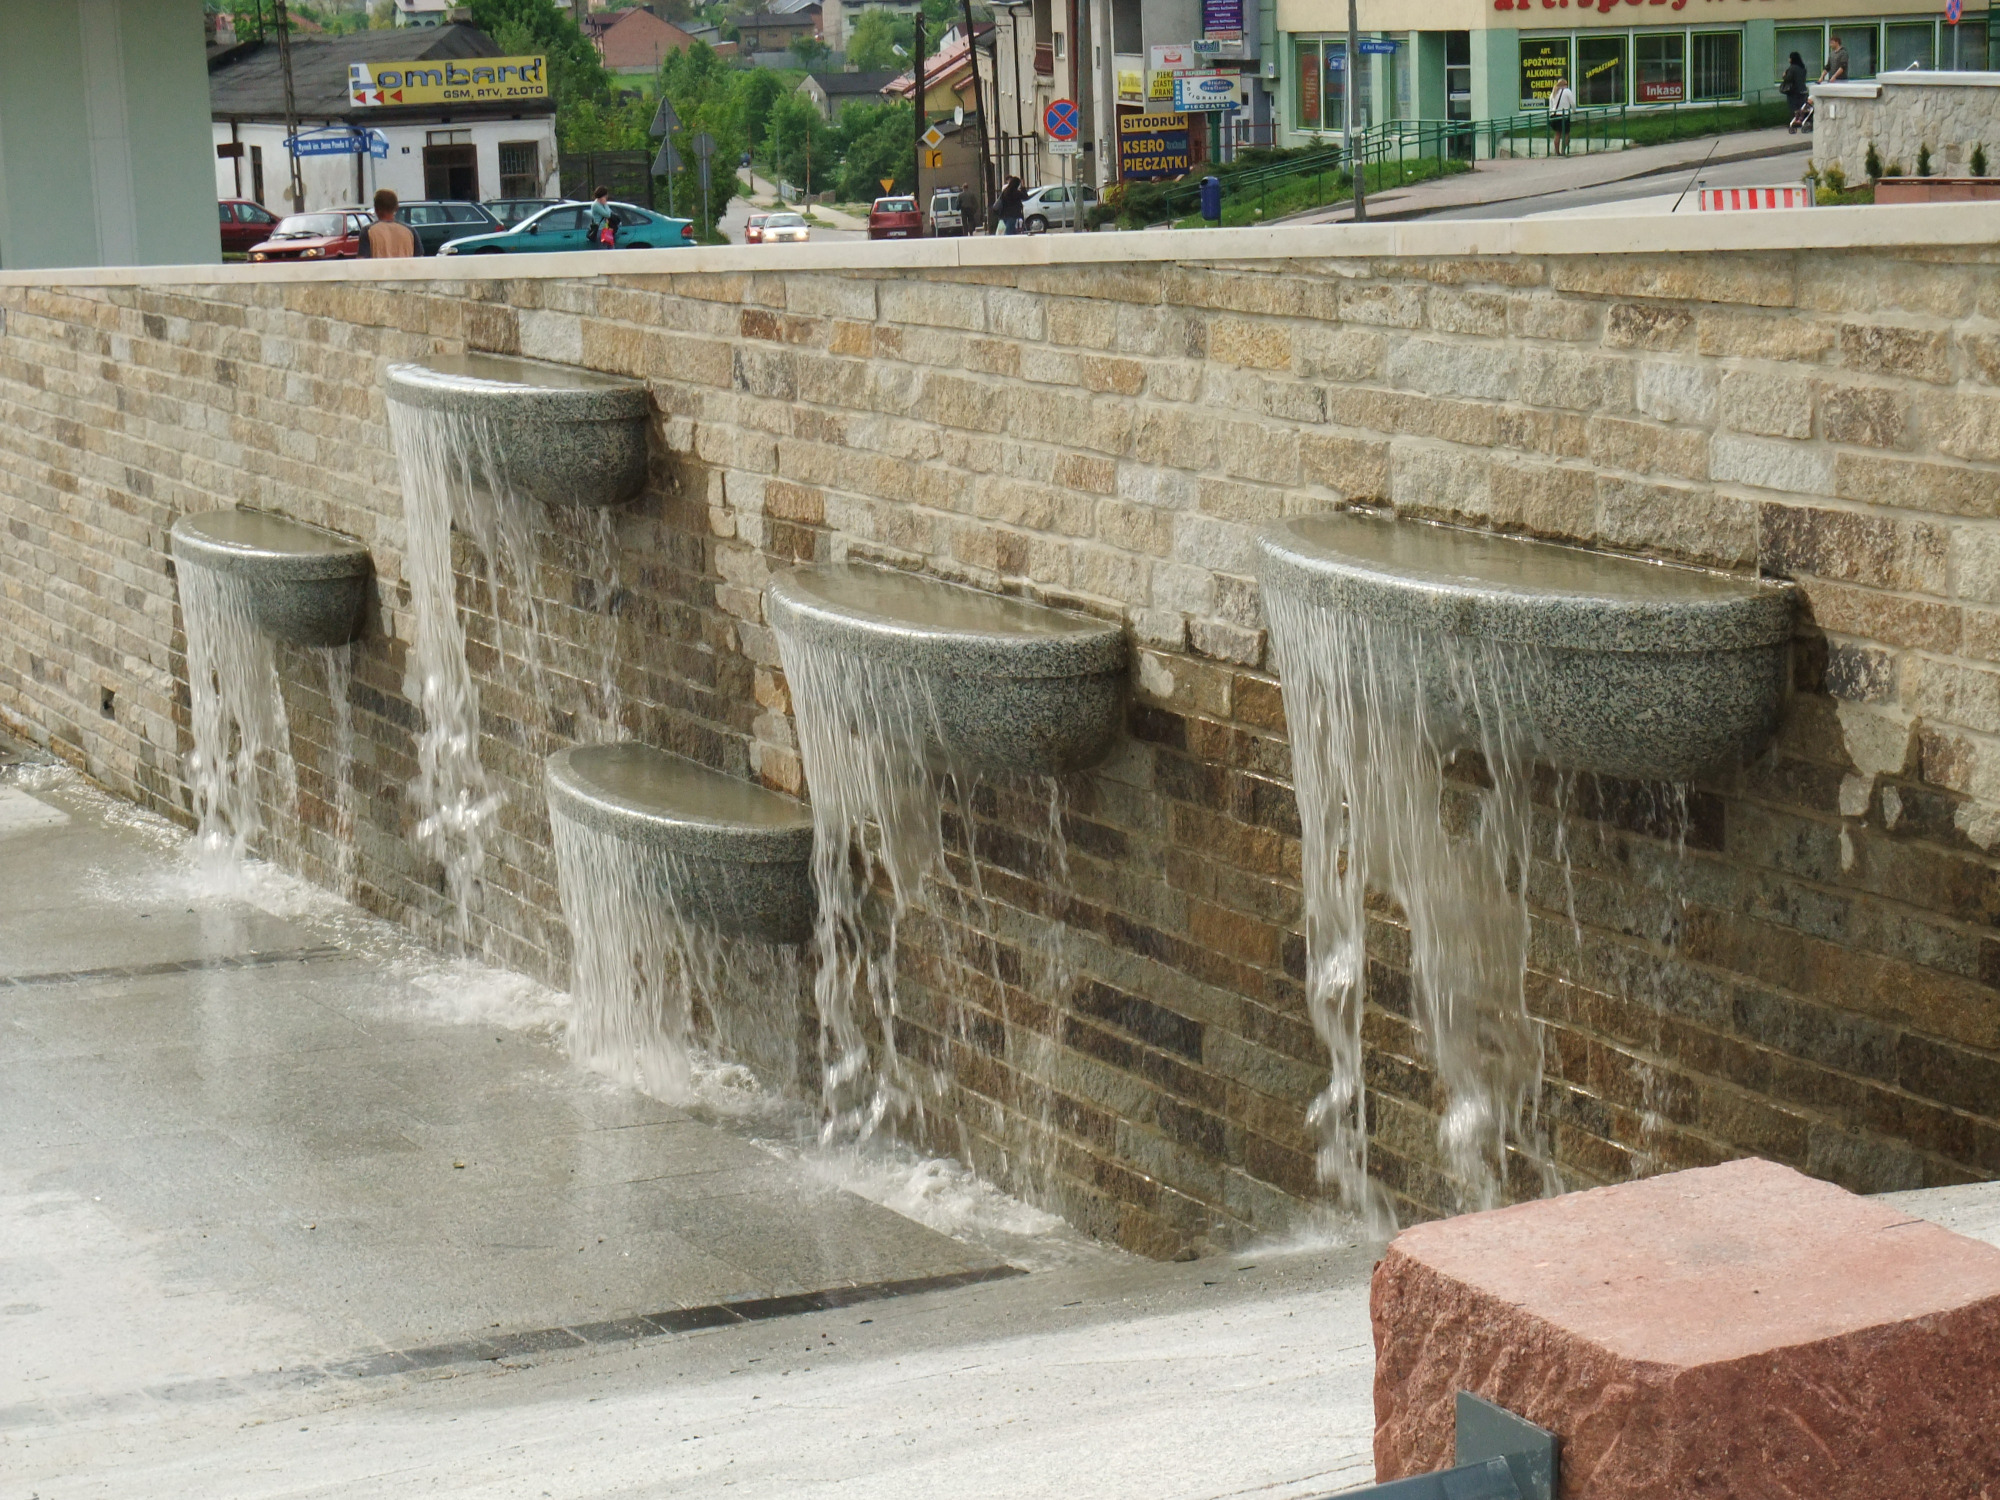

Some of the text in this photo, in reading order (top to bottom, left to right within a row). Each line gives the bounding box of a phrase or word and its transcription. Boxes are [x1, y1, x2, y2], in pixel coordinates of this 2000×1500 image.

[1523, 56, 1567, 67] SPOŻYWCZE
[1526, 68, 1563, 78] ALKOHOLE
[1585, 57, 1619, 79] ZAPRASZAMY
[351, 58, 541, 91] Lombard
[443, 89, 475, 99] GSM,
[477, 88, 503, 98] RTV,
[1532, 91, 1551, 99] PRAS
[1646, 84, 1682, 96] Inkaso
[1123, 116, 1185, 129] SITODRUK
[1123, 138, 1165, 154] KSERO
[1123, 155, 1188, 172] PIECZĄTKI
